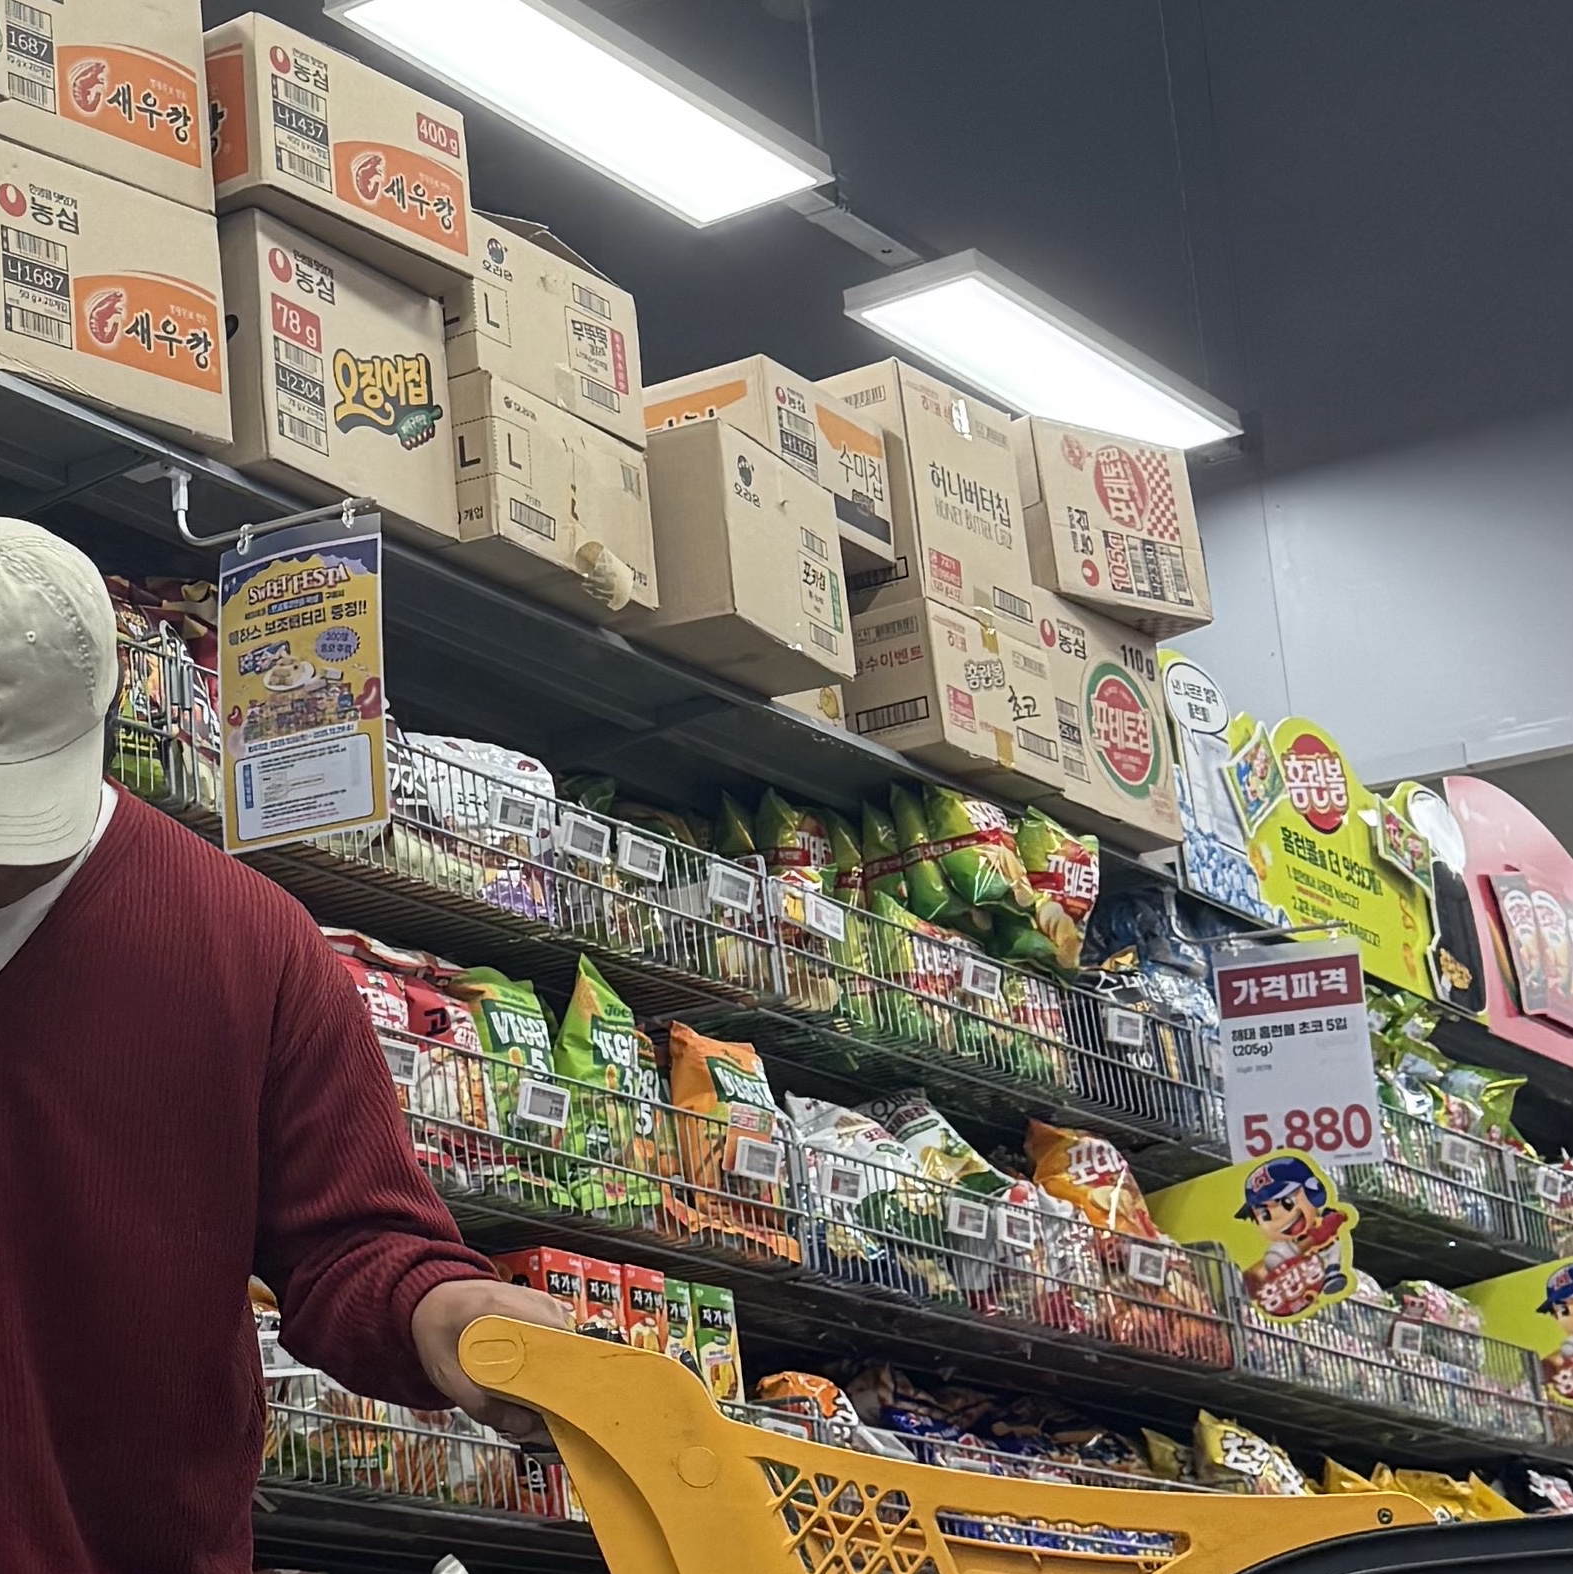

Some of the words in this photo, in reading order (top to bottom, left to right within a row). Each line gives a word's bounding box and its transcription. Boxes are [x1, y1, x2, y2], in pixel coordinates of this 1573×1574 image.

[8, 30, 49, 57] 1687
[293, 58, 329, 92] 농심
[106, 82, 192, 143] 새우깡
[277, 106, 324, 140] 나1437
[419, 119, 447, 147] 400
[449, 138, 459, 155] g
[30, 197, 79, 235] 농심
[384, 176, 456, 231] 새우깡
[7, 260, 64, 292] 나1687
[295, 263, 336, 306] 농심
[482, 260, 514, 282] 오리온
[124, 310, 212, 370] 새우깡
[276, 302, 301, 335] 78
[306, 325, 317, 347] g
[279, 368, 322, 401] 나2304
[333, 349, 431, 427] 오징어집
[838, 445, 884, 501] 수미칩
[1096, 447, 1144, 532] 포테토칩
[929, 461, 1011, 529] 허니버터칩
[248, 575, 290, 605] SWEET
[291, 563, 350, 595] FESTA
[1058, 630, 1087, 660] 농심
[1120, 644, 1145, 674] 110
[1146, 662, 1156, 682] g
[1008, 685, 1042, 722] 초코
[1091, 693, 1151, 755] 포테토칩
[1283, 751, 1349, 813] 홈런볼
[1328, 847, 1343, 877] 더
[1231, 967, 1349, 1006] 가격파격
[1231, 1028, 1256, 1042] 해태
[1260, 1024, 1295, 1040] 홈런볼
[1299, 1020, 1323, 1035] 초코
[1326, 1017, 1348, 1031] 5입
[1232, 1042, 1273, 1057] (205g)
[1257, 1253, 1326, 1312] 홈런볼
[668, 1301, 690, 1321] 가비
